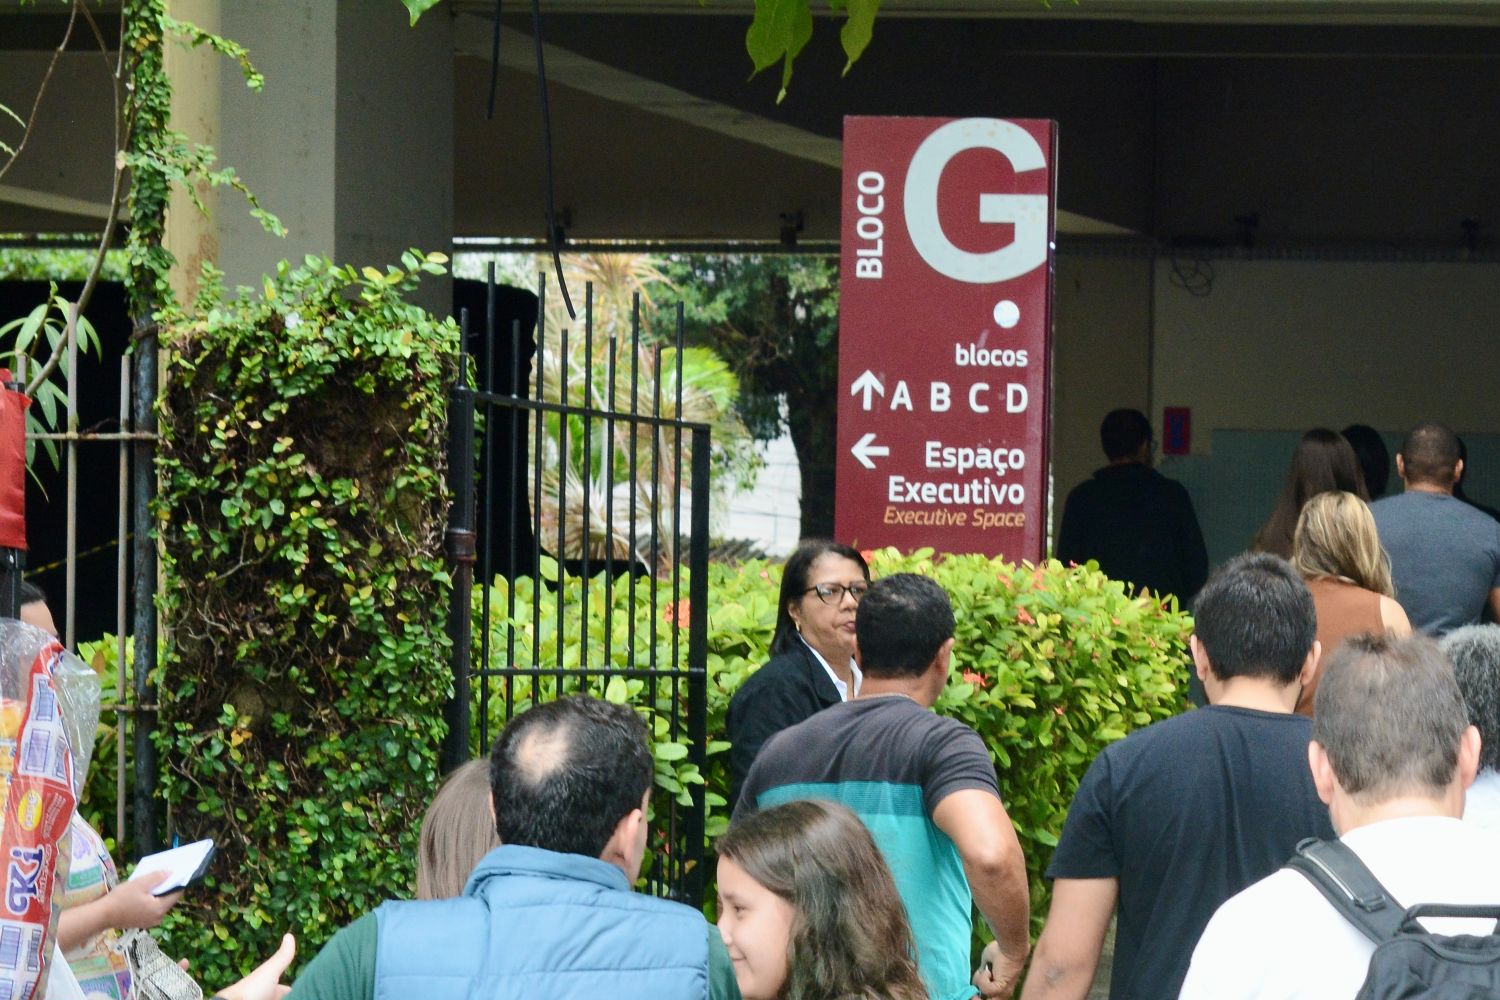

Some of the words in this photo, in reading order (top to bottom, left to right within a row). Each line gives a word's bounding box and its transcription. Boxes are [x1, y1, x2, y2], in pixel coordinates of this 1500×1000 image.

[903, 117, 1049, 284] G
[856, 170, 885, 280] BLOCO
[955, 342, 1028, 367] blocos
[890, 380, 914, 412] A
[930, 381, 952, 413] B
[968, 382, 990, 414] C
[1006, 382, 1029, 414] D
[925, 440, 1026, 476] Espaço
[888, 475, 1026, 505] Executivo
[884, 506, 967, 527] Executive
[972, 508, 1026, 530] Space
